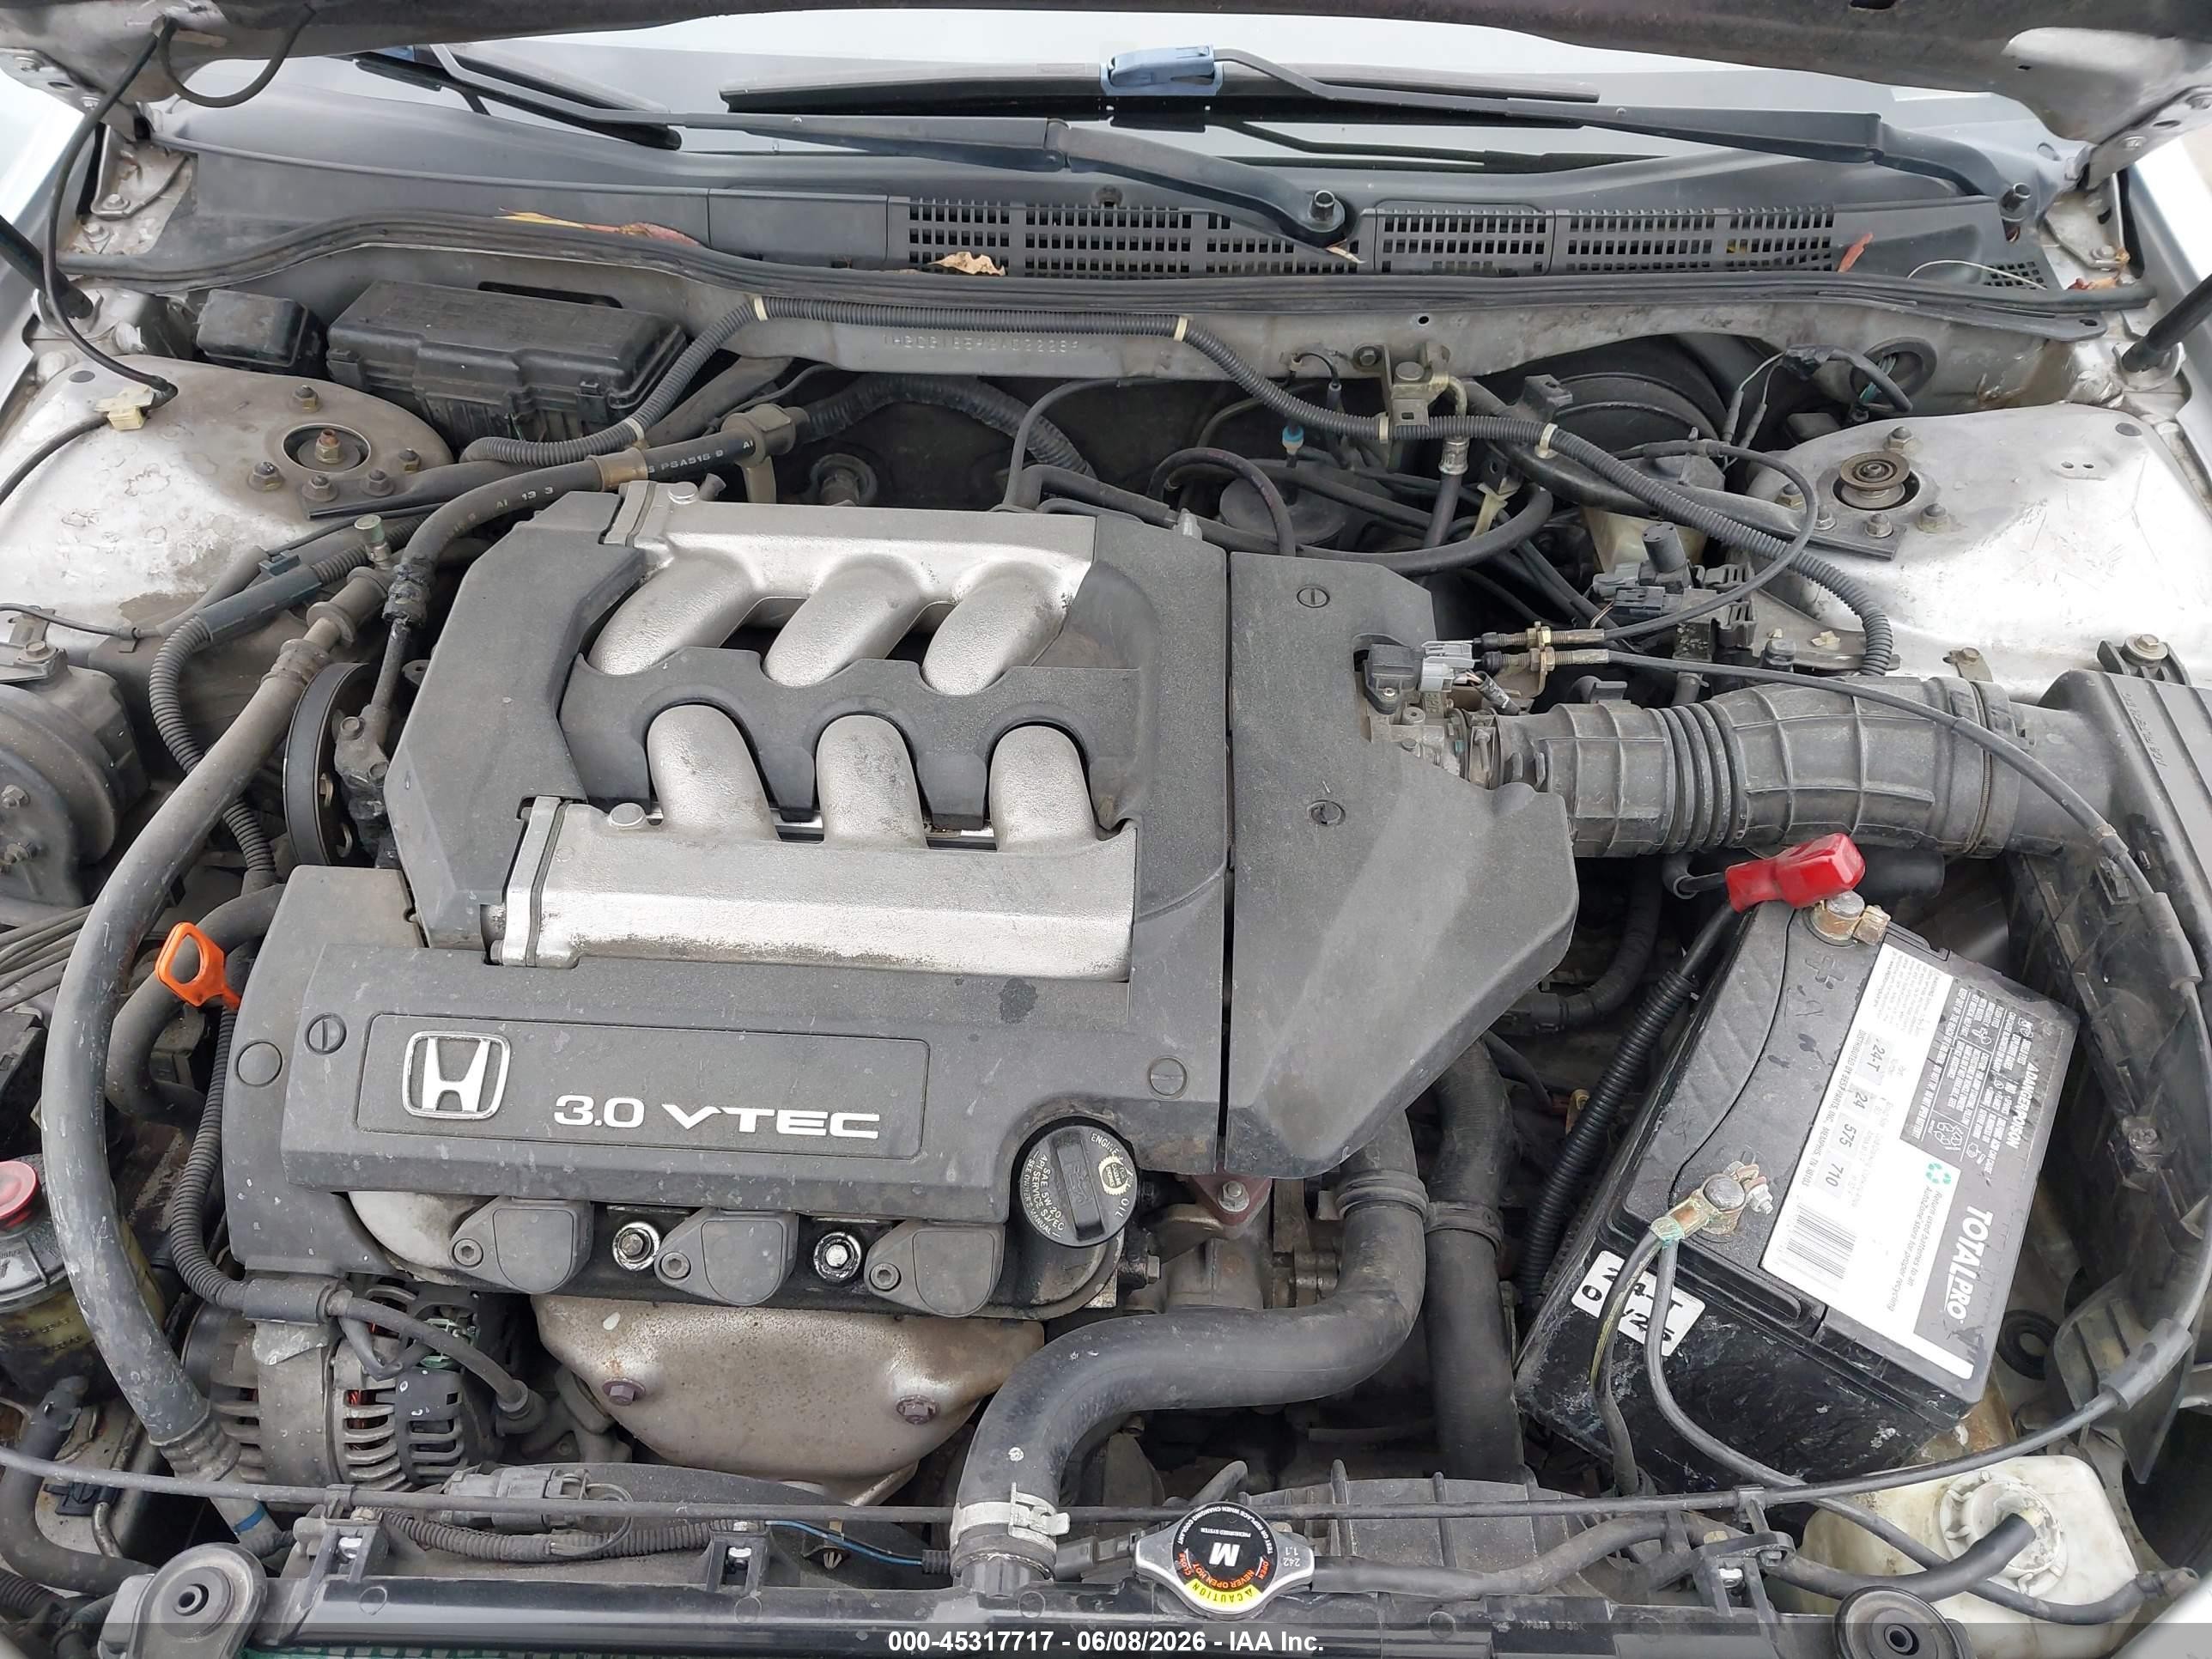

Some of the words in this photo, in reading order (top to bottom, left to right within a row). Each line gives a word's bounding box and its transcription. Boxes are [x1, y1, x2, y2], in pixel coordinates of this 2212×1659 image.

[1848, 1030, 1865, 1066] DISTRIBUTED
[1853, 1091, 1868, 1109] 24
[2006, 1071, 2038, 1150] DANGER/POISON
[554, 1094, 645, 1128] 3.0
[661, 1103, 880, 1139] VTEC
[1839, 1124, 1856, 1147] 575
[1036, 1153, 1048, 1170] API
[1040, 1167, 1051, 1188] SAE
[1091, 1133, 1120, 1158] ENGINE
[1115, 1198, 1131, 1218] OIL
[1802, 1167, 1814, 1187] 38103
[1826, 1164, 1844, 1187] 710
[1031, 1170, 1044, 1209] SERVICE
[1042, 1192, 1062, 1218] 5W-20
[1929, 1191, 1942, 1215] Return
[1040, 1208, 1065, 1231] SJ/EC
[1887, 1278, 1903, 1311] recycling
[1193, 1506, 1222, 1522] CHANGING
[1221, 1506, 1241, 1516] WHEN
[1239, 1510, 1266, 1531] REPLACE
[1176, 1519, 1195, 1546] COOLANT
[1261, 1528, 1269, 1540] OR
[1208, 1542, 1241, 1567] M
[1282, 1557, 1301, 1567] 242
[1284, 1546, 1299, 1556] 1.1
[1177, 1552, 1193, 1577] CLOSE
[1191, 1563, 1208, 1581] HOT
[1257, 1560, 1270, 1581] OPEN
[1206, 1574, 1231, 1589] OPEN
[1230, 1569, 1255, 1589] NEVER
[1191, 1579, 1244, 1603] CAUTION
